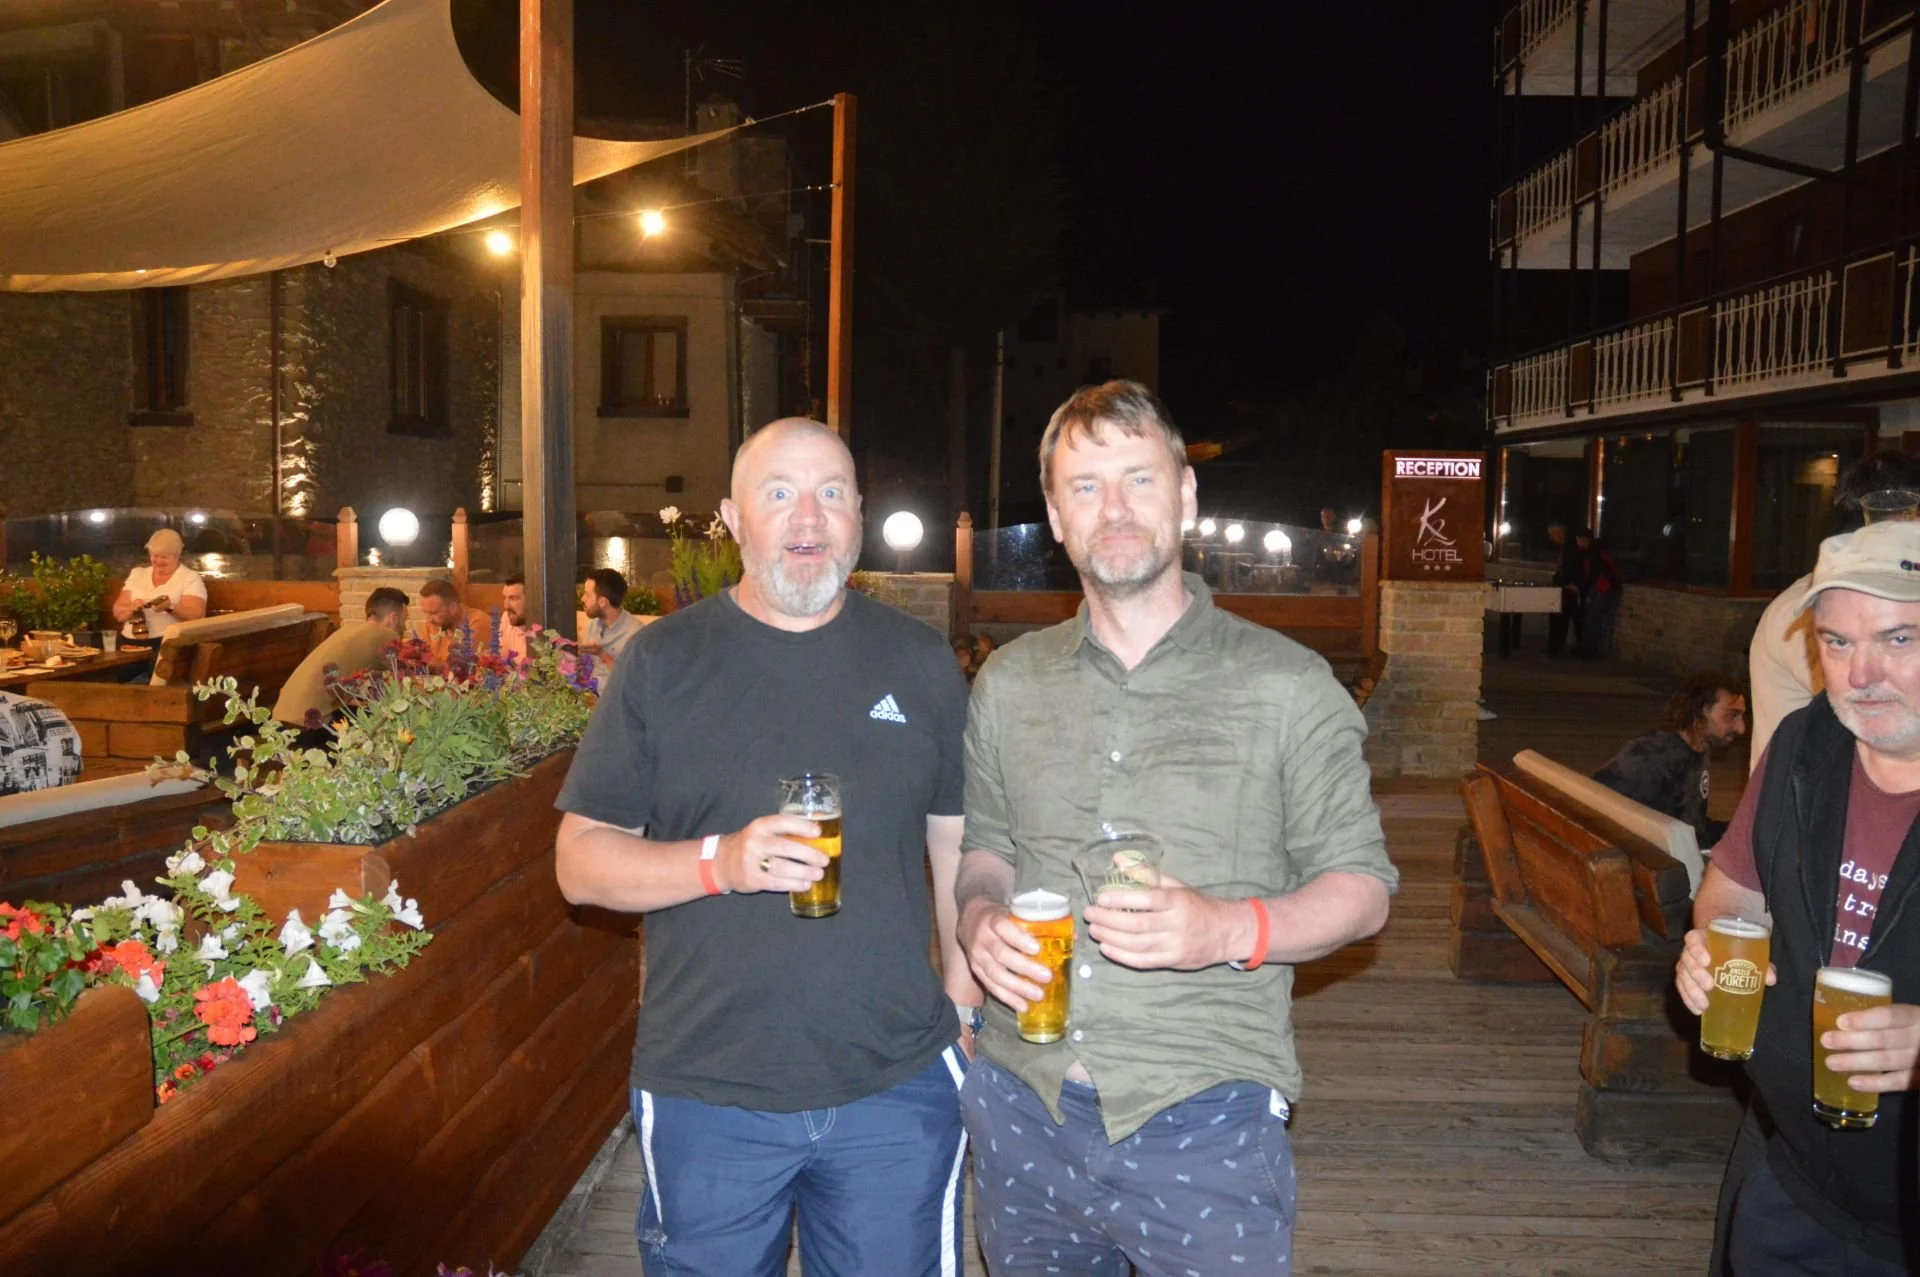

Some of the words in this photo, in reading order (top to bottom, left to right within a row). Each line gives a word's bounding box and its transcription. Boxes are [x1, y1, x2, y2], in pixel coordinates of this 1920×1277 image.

[1396, 461, 1480, 476] RECEPTION
[1412, 548, 1463, 561] HOTEL
[869, 709, 907, 723] adidas
[1840, 860, 1888, 890] days
[1720, 972, 1757, 988] PORETTI
